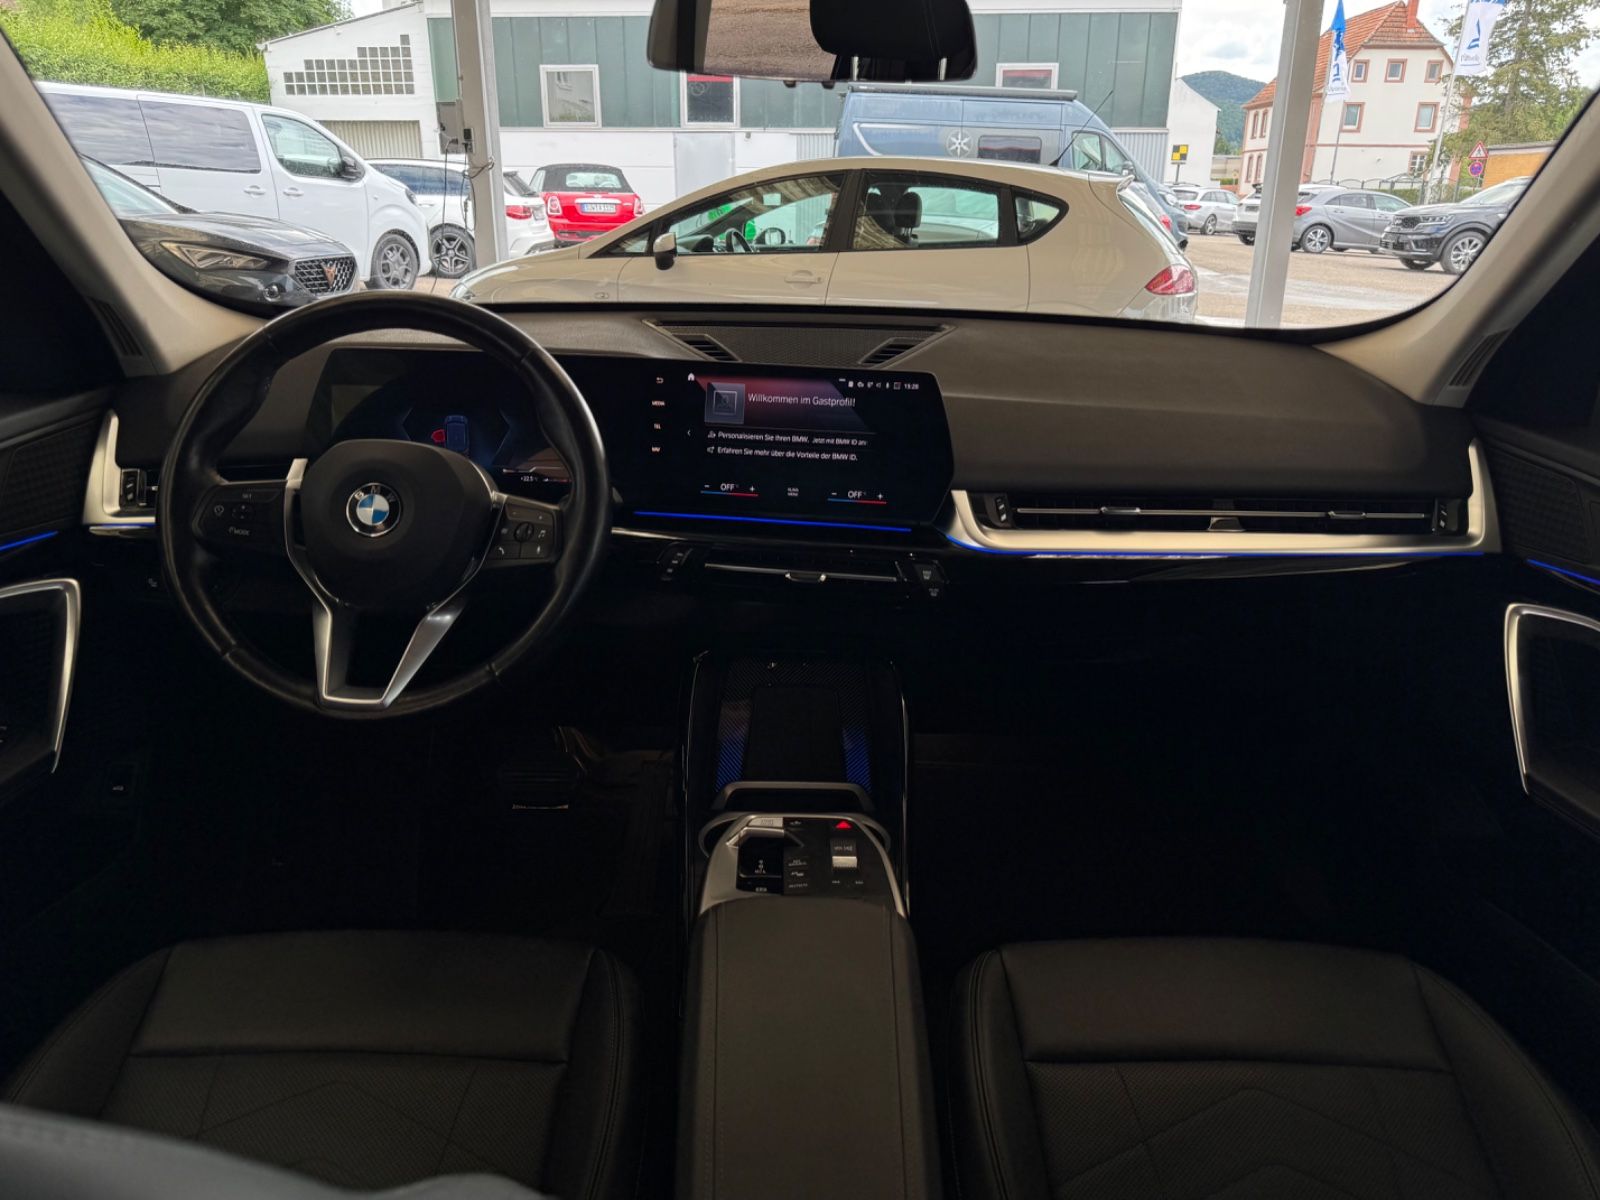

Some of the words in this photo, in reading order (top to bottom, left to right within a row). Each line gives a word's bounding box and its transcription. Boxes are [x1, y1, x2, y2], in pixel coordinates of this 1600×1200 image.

[748, 393, 799, 404] Willkommen
[800, 396, 811, 404] im
[812, 396, 856, 407] Gastprofil!
[718, 431, 764, 441] Personalisieren
[775, 434, 791, 442] Ihren
[717, 446, 743, 455] Erfahren
[770, 449, 785, 457] über
[796, 451, 820, 459] Vorteile
[720, 483, 735, 492] OFF
[847, 490, 863, 499] OFF
